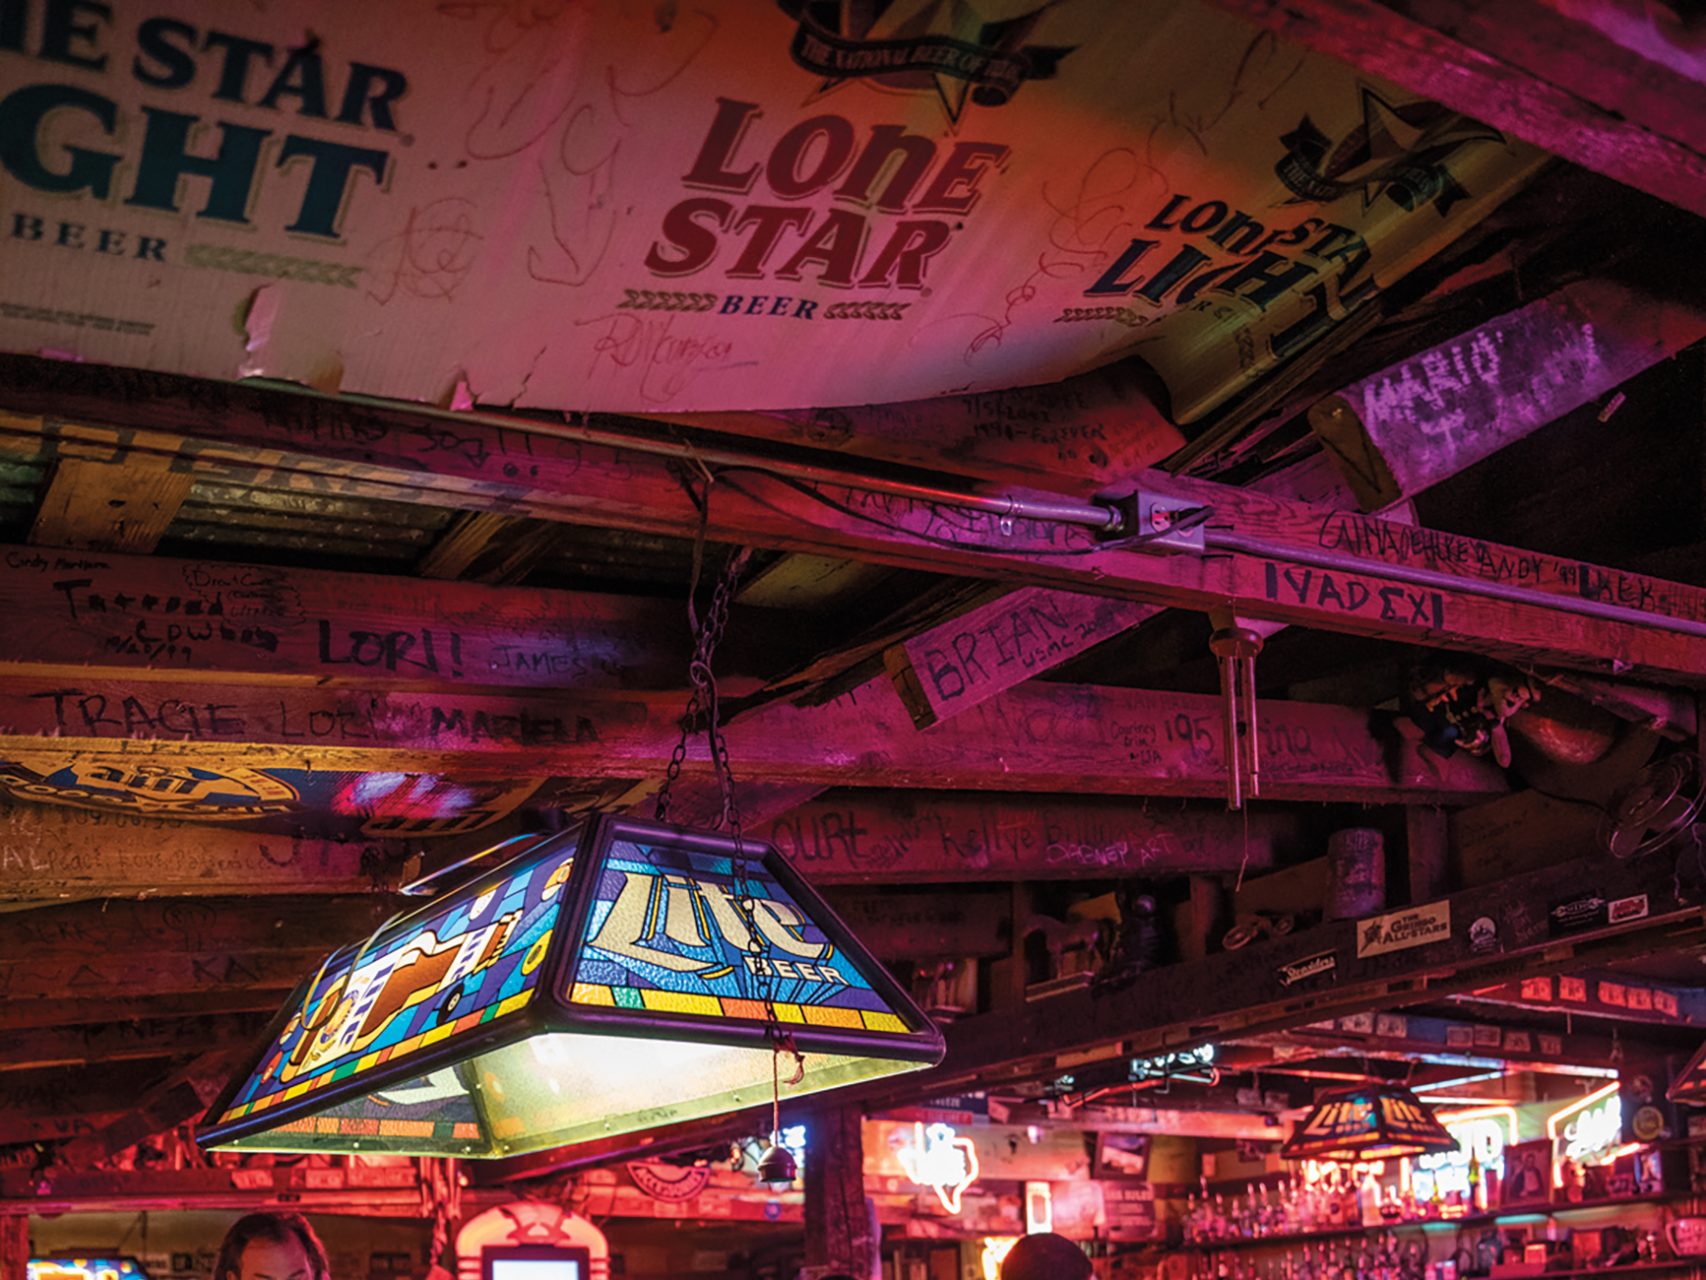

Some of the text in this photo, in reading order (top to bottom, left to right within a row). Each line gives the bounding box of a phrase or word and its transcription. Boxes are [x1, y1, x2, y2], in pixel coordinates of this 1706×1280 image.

[132, 17, 408, 132] STAR
[10, 212, 167, 263] BEER
[643, 197, 955, 292] STAR
[718, 294, 820, 321] BEER
[926, 600, 1068, 700] BRIAN
[588, 871, 834, 973] Lite
